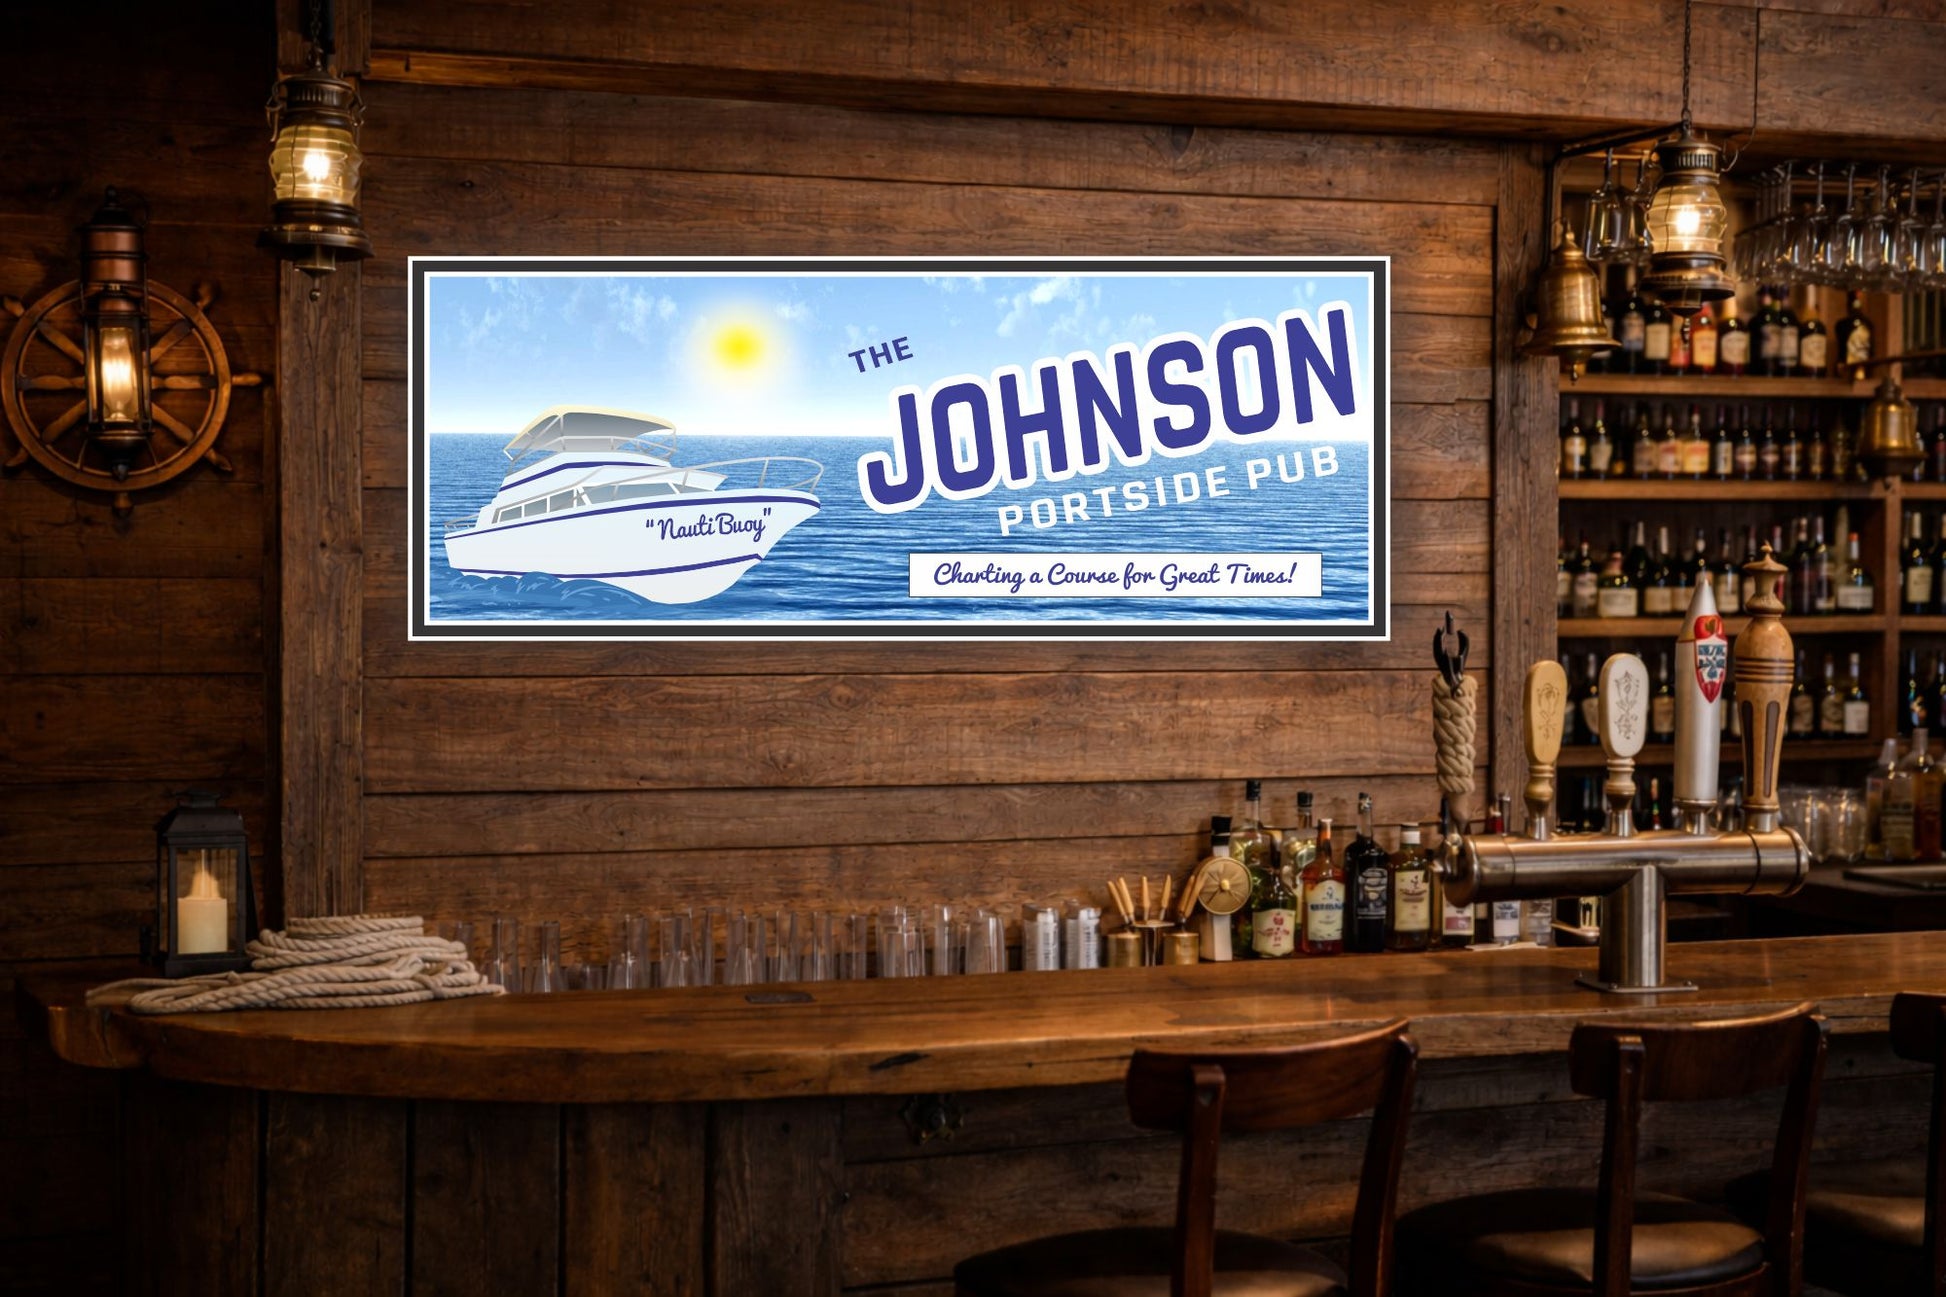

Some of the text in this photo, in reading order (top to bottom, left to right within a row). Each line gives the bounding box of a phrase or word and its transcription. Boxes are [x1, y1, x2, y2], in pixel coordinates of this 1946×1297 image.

[847, 335, 914, 374] THE
[866, 308, 1357, 506] JOHNSON
[998, 445, 1340, 537] PORTSIDE PUB
[933, 561, 1298, 592] Charting a Course for Great Times!
